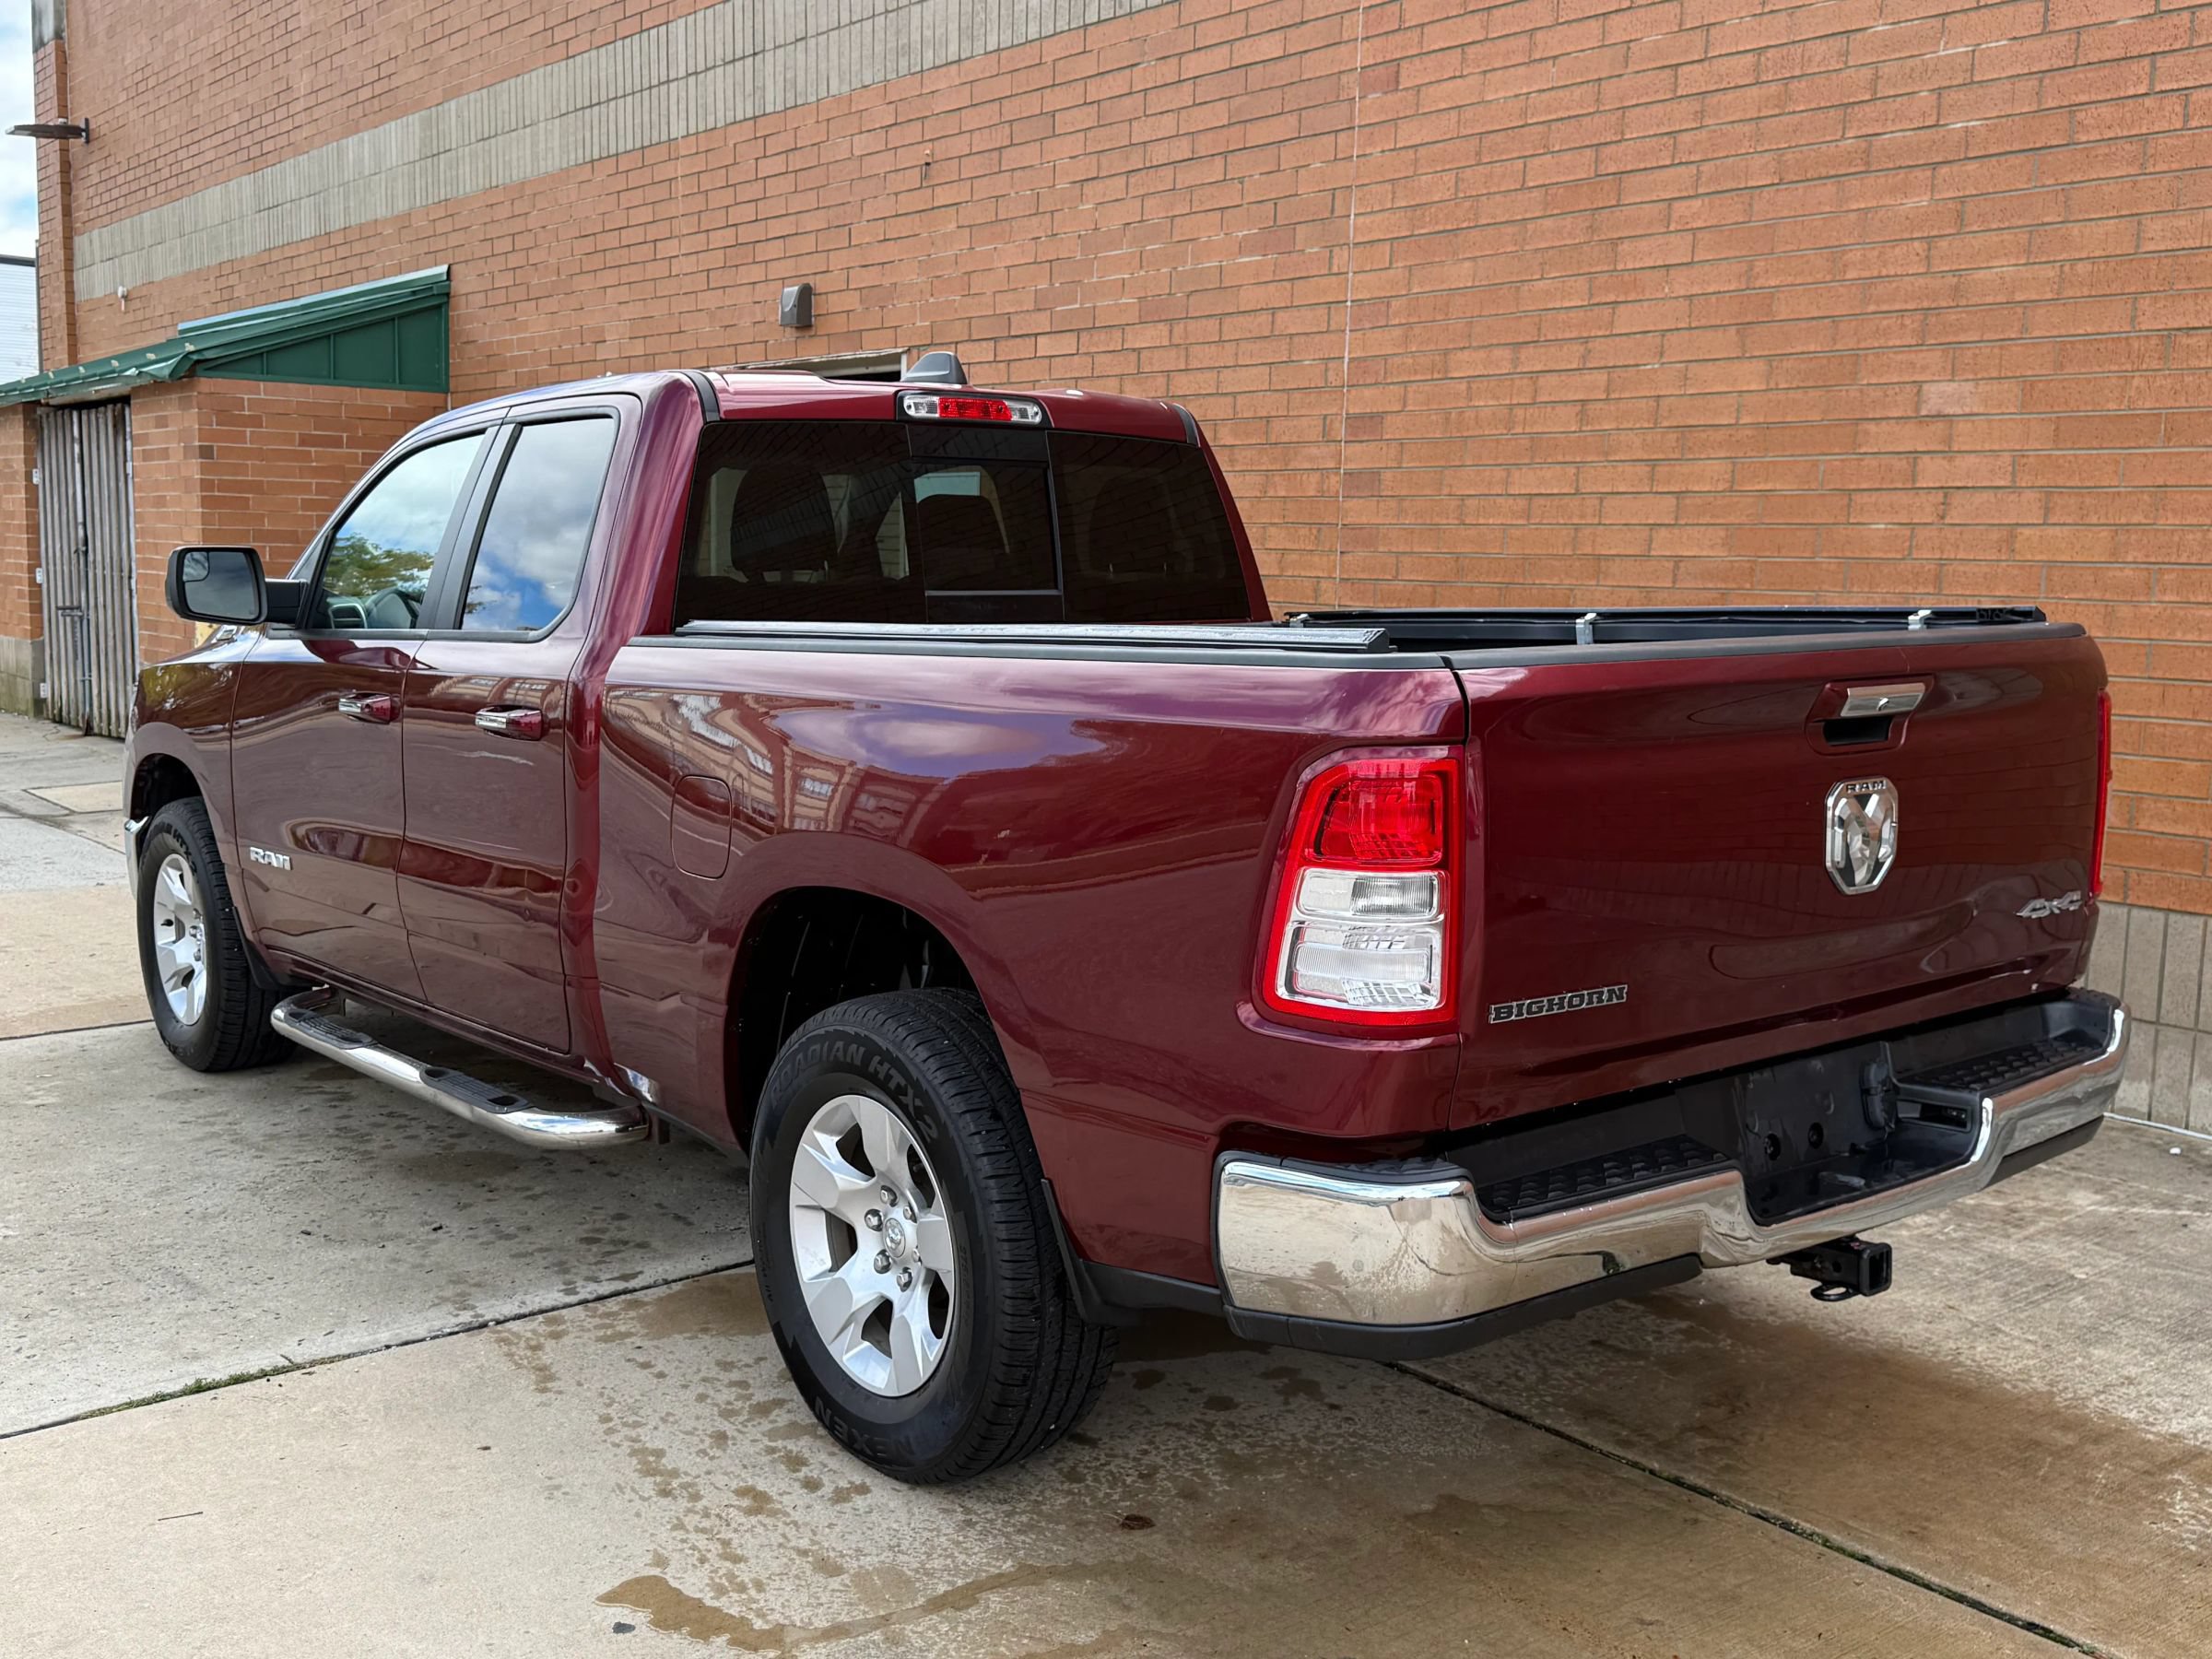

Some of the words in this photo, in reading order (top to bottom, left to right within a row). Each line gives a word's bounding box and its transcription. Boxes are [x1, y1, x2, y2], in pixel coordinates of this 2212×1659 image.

[1845, 780, 1887, 794] RAM
[249, 846, 292, 871] RAM
[1488, 984, 1628, 1024] BIGHORN
[815, 1395, 915, 1458] NEXEN
